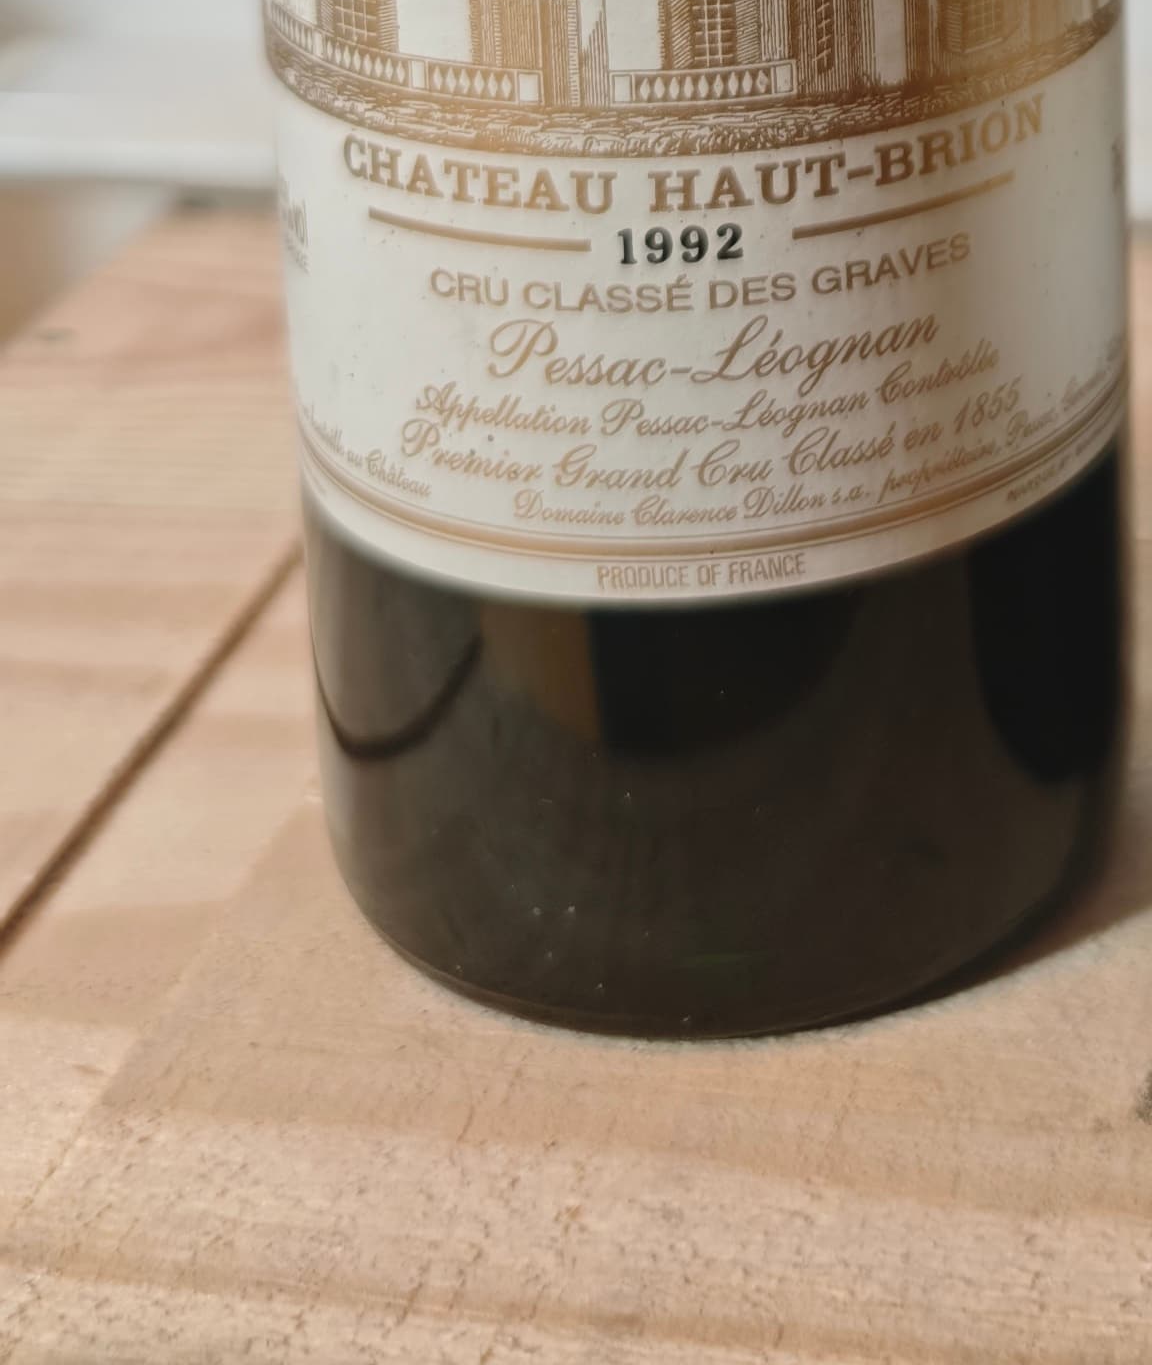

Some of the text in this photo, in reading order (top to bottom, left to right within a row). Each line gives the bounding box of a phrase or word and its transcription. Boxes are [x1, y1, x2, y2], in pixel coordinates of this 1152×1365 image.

[343, 132, 618, 215] CHATEAU
[647, 92, 1048, 213] HAUT-BRION
[429, 232, 972, 313] CRU CLASSÉ DES GRAVES
[616, 222, 745, 265] 1992
[487, 312, 941, 399] Pessac-Léognan
[401, 418, 545, 483] Premier
[550, 443, 694, 491] Grand
[696, 439, 775, 487] Cru
[785, 423, 897, 477] Classé
[903, 420, 944, 451] en
[953, 373, 1024, 437] 1855
[415, 381, 593, 436] Appellation
[600, 389, 871, 439] Pessac-Léognan
[513, 488, 625, 526] Domaine
[630, 494, 738, 525] Clarence
[743, 485, 827, 520] Dillon
[595, 552, 807, 591] PRODUCE OF FRANCE
